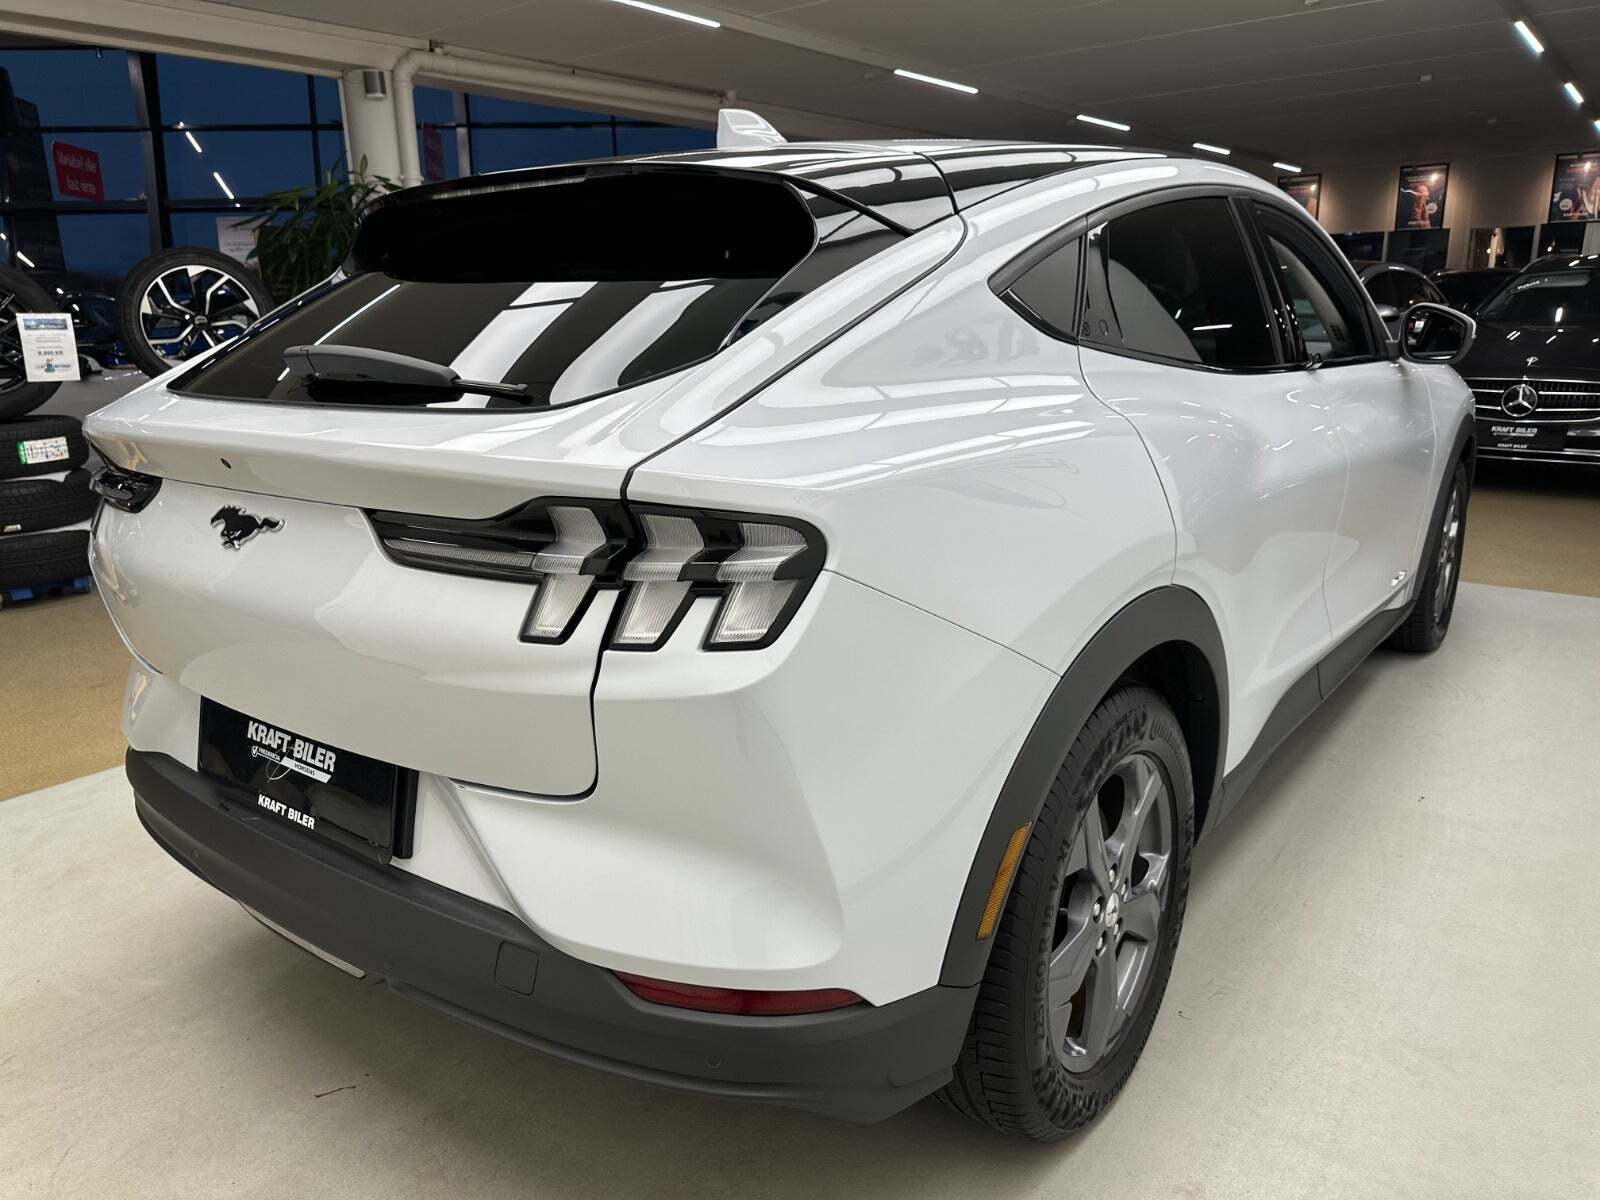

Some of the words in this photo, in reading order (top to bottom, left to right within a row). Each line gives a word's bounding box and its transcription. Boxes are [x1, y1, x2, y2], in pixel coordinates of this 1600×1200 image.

[1491, 425, 1514, 433] KRAFT
[247, 720, 291, 753] KRAFT
[293, 738, 336, 773] BILER
[257, 794, 287, 816] KRAFT
[288, 807, 315, 830] BILER
